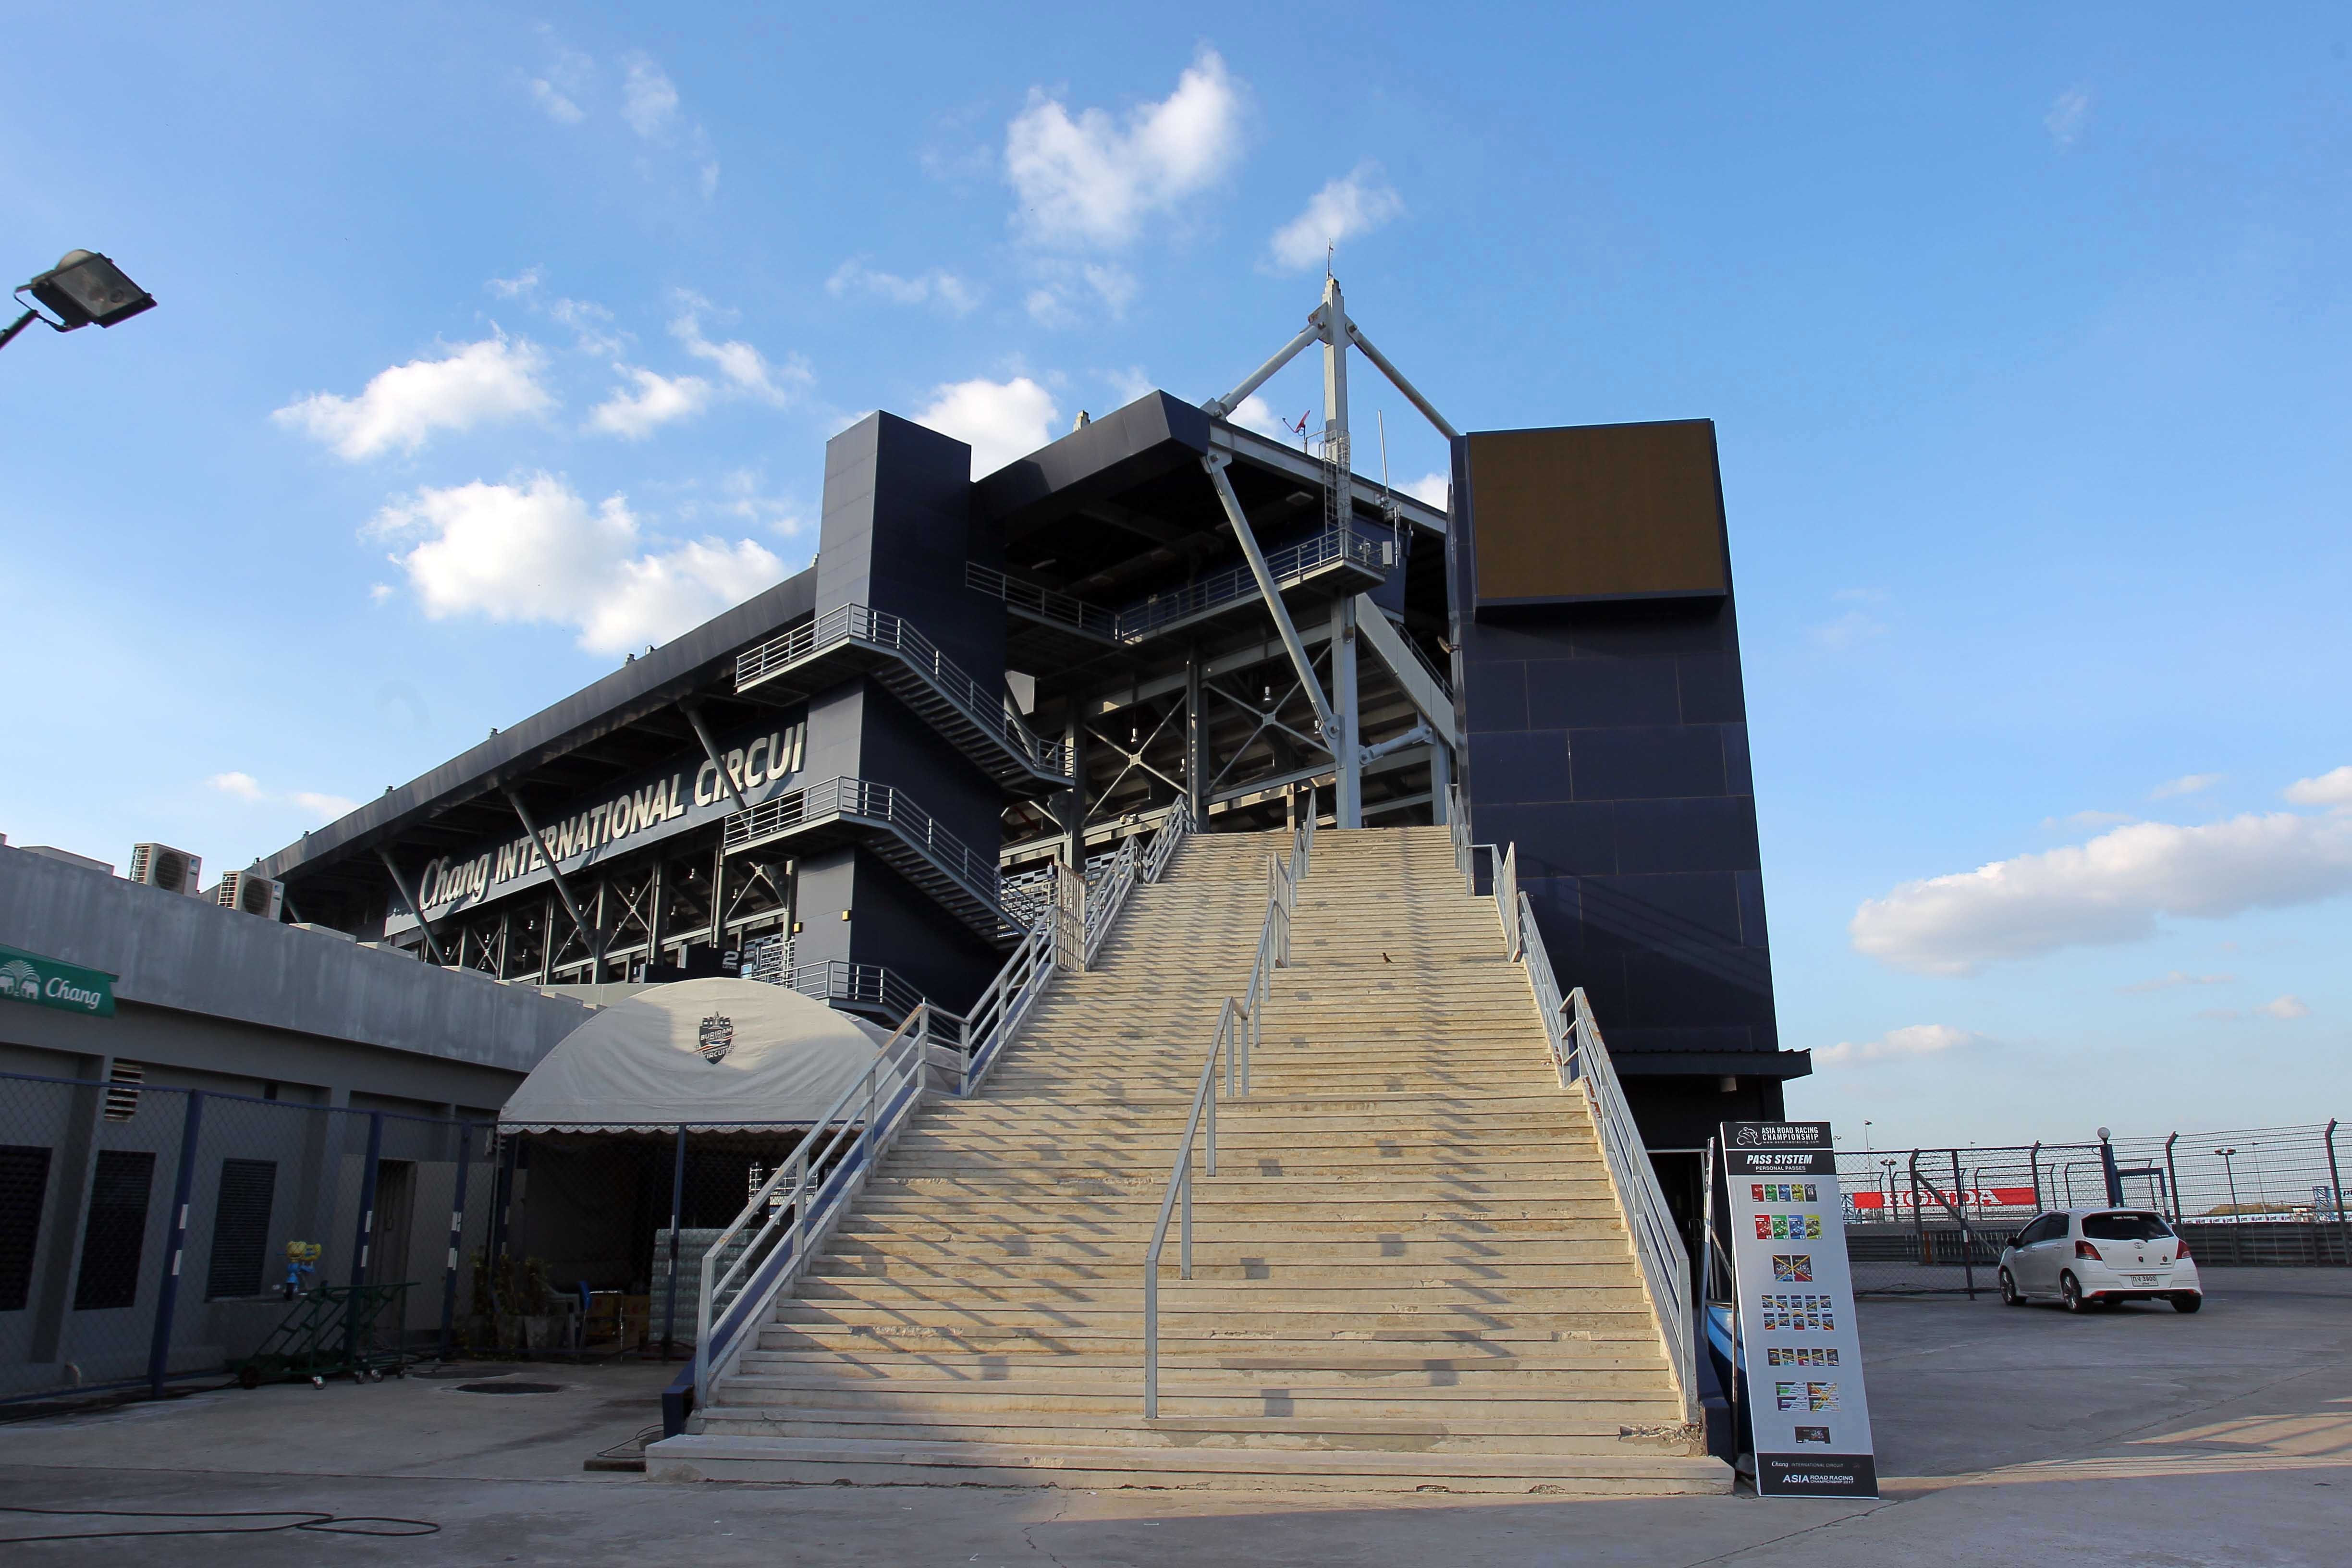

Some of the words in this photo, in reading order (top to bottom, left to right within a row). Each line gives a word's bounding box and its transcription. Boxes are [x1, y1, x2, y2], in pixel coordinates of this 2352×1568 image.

[419, 852, 492, 910] Chang
[495, 773, 686, 884] INTERNATIONAL
[695, 722, 806, 807] CIRCUI
[723, 951, 739, 966] 2
[45, 977, 102, 1009] Chang
[1746, 1155, 1772, 1164] PASS
[1775, 1154, 1813, 1164] SYSTEM
[1882, 1189, 2002, 1207] HONDA
[1782, 1475, 1810, 1483] ASIA
